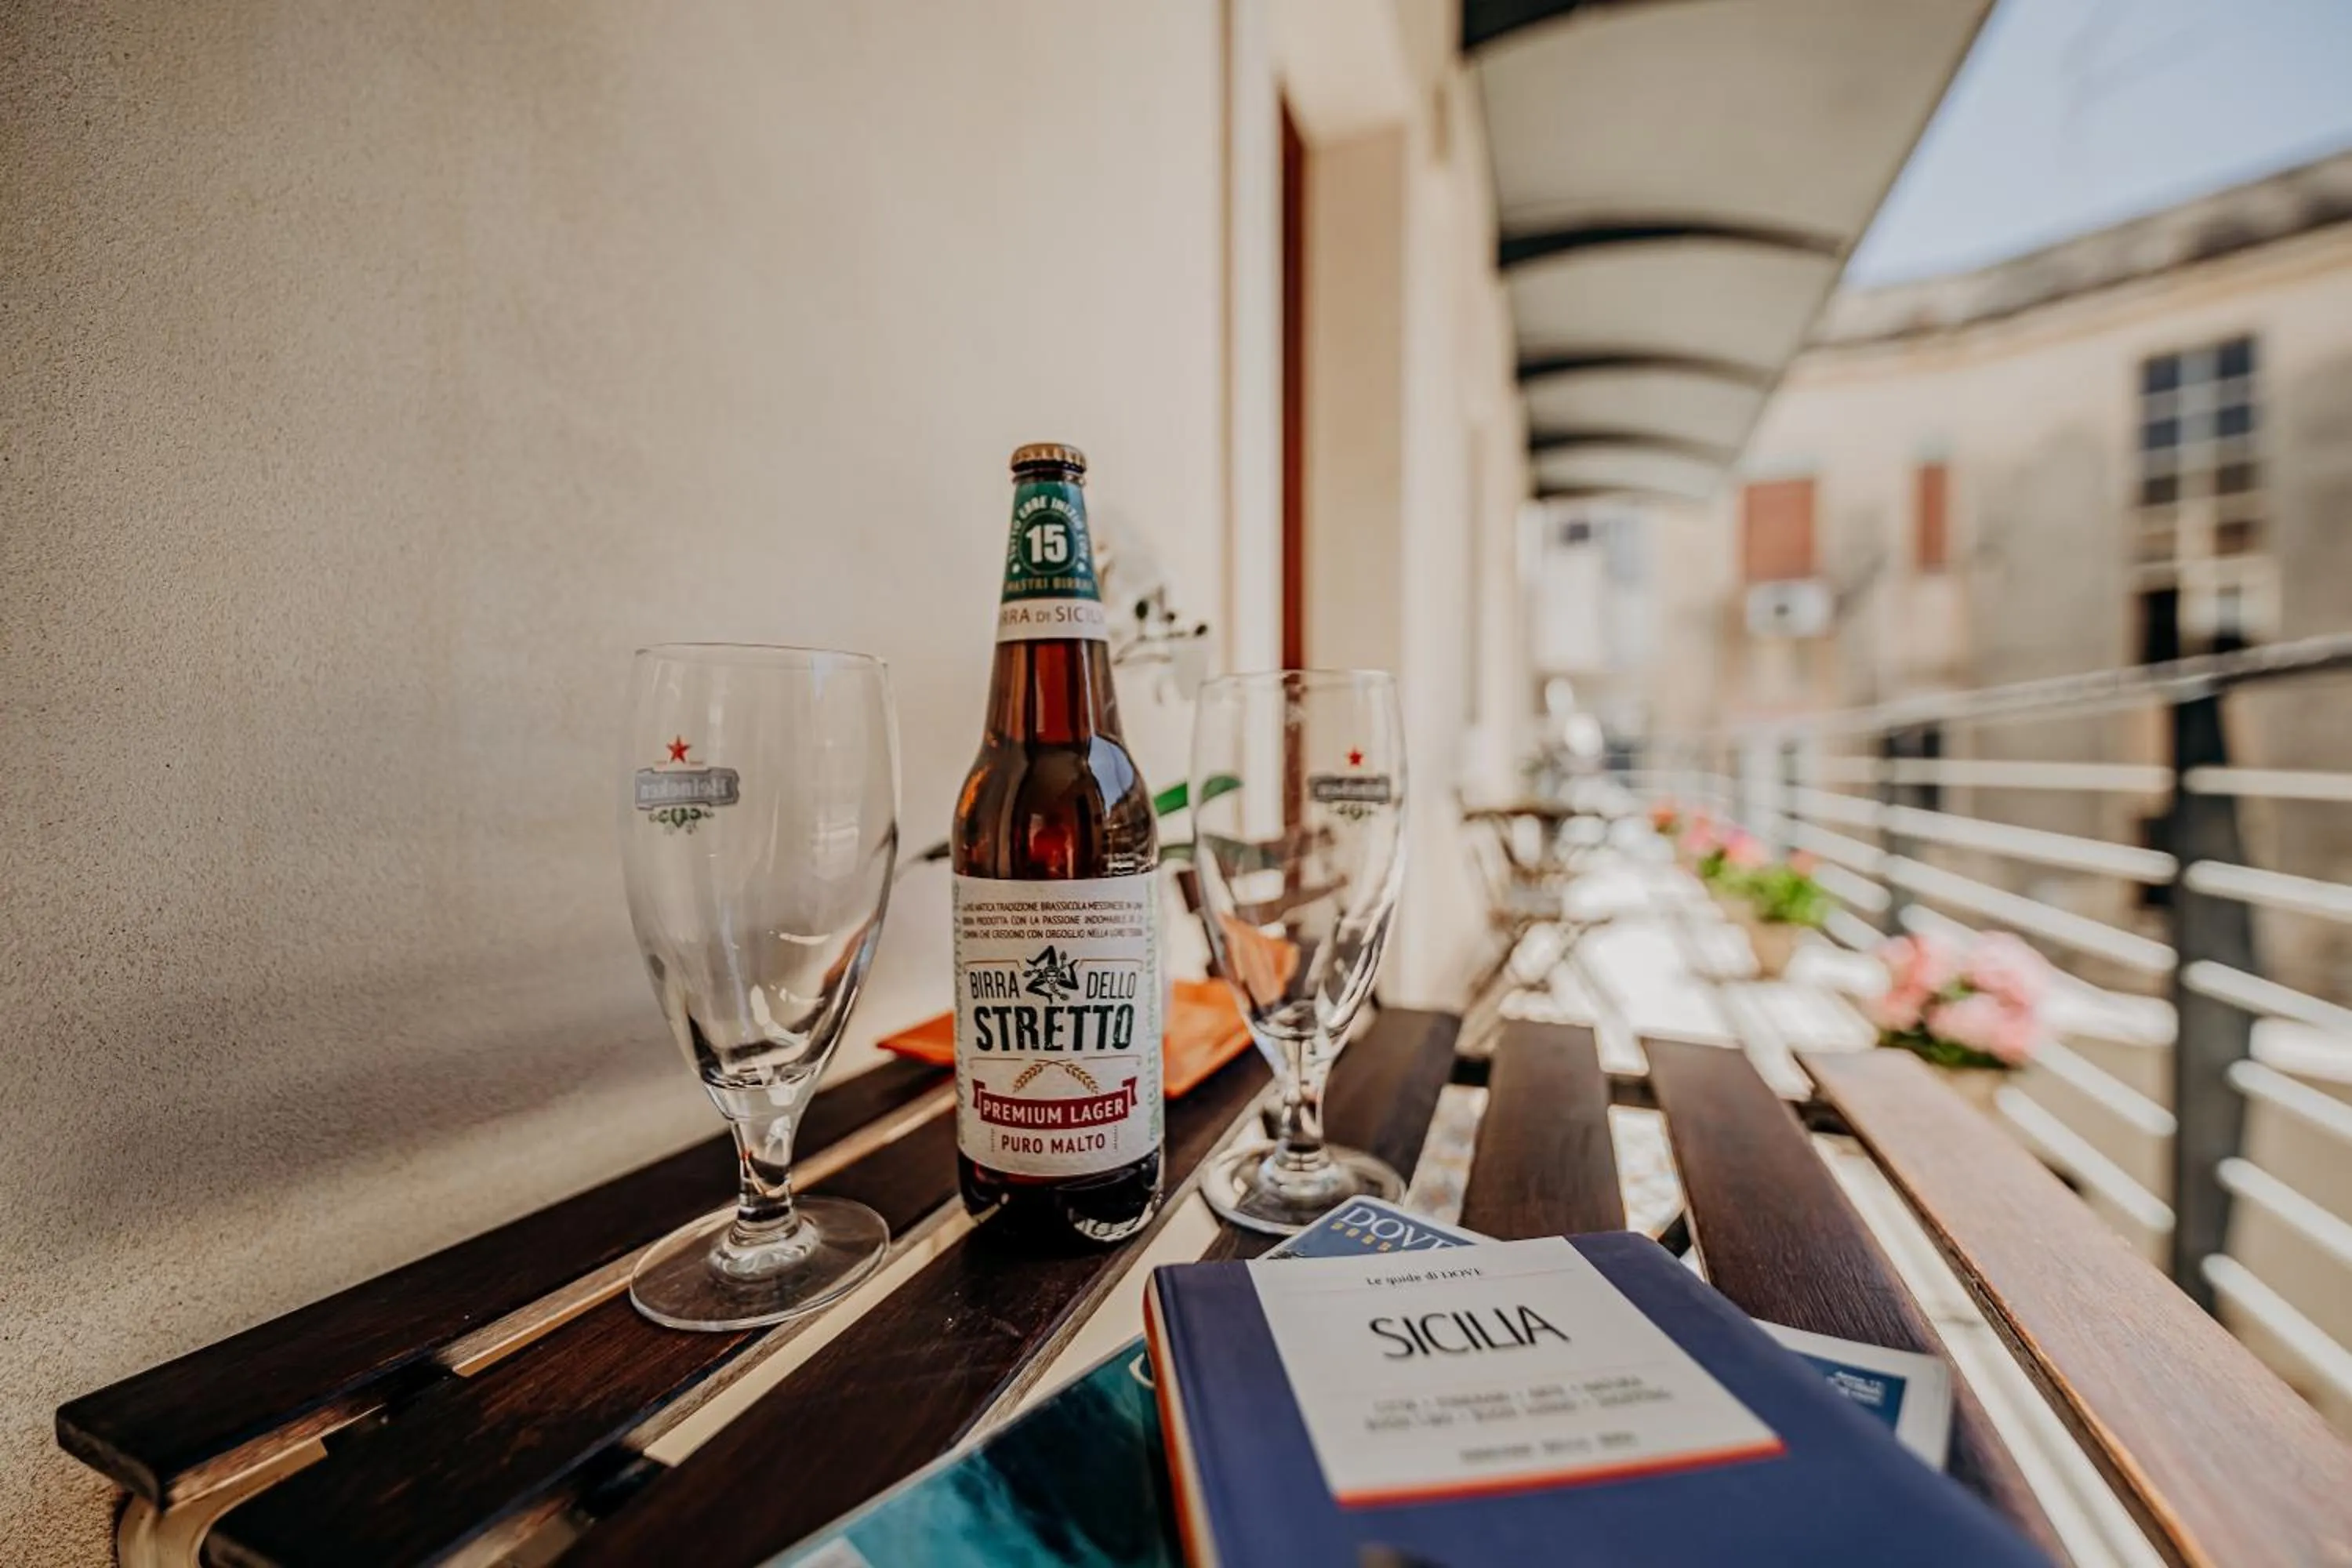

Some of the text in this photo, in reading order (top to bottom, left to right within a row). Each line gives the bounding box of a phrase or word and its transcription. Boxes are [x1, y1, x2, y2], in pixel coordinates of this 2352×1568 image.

[1025, 523, 1068, 563] 15
[1011, 915, 1026, 924] CON
[1030, 916, 1040, 925] LA
[1042, 915, 1080, 924] PASSIONE
[1027, 930, 1044, 938] CON
[1045, 930, 1086, 938] ORGOGLIO
[970, 971, 1137, 1000] BIRRA DELLO
[973, 1004, 1134, 1052] STRETTO
[982, 1098, 1124, 1123] PREMIUM LAGER
[1000, 1134, 1044, 1154] PURO
[1051, 1133, 1105, 1154] MALTO
[1369, 1305, 1570, 1359] SICILIA
